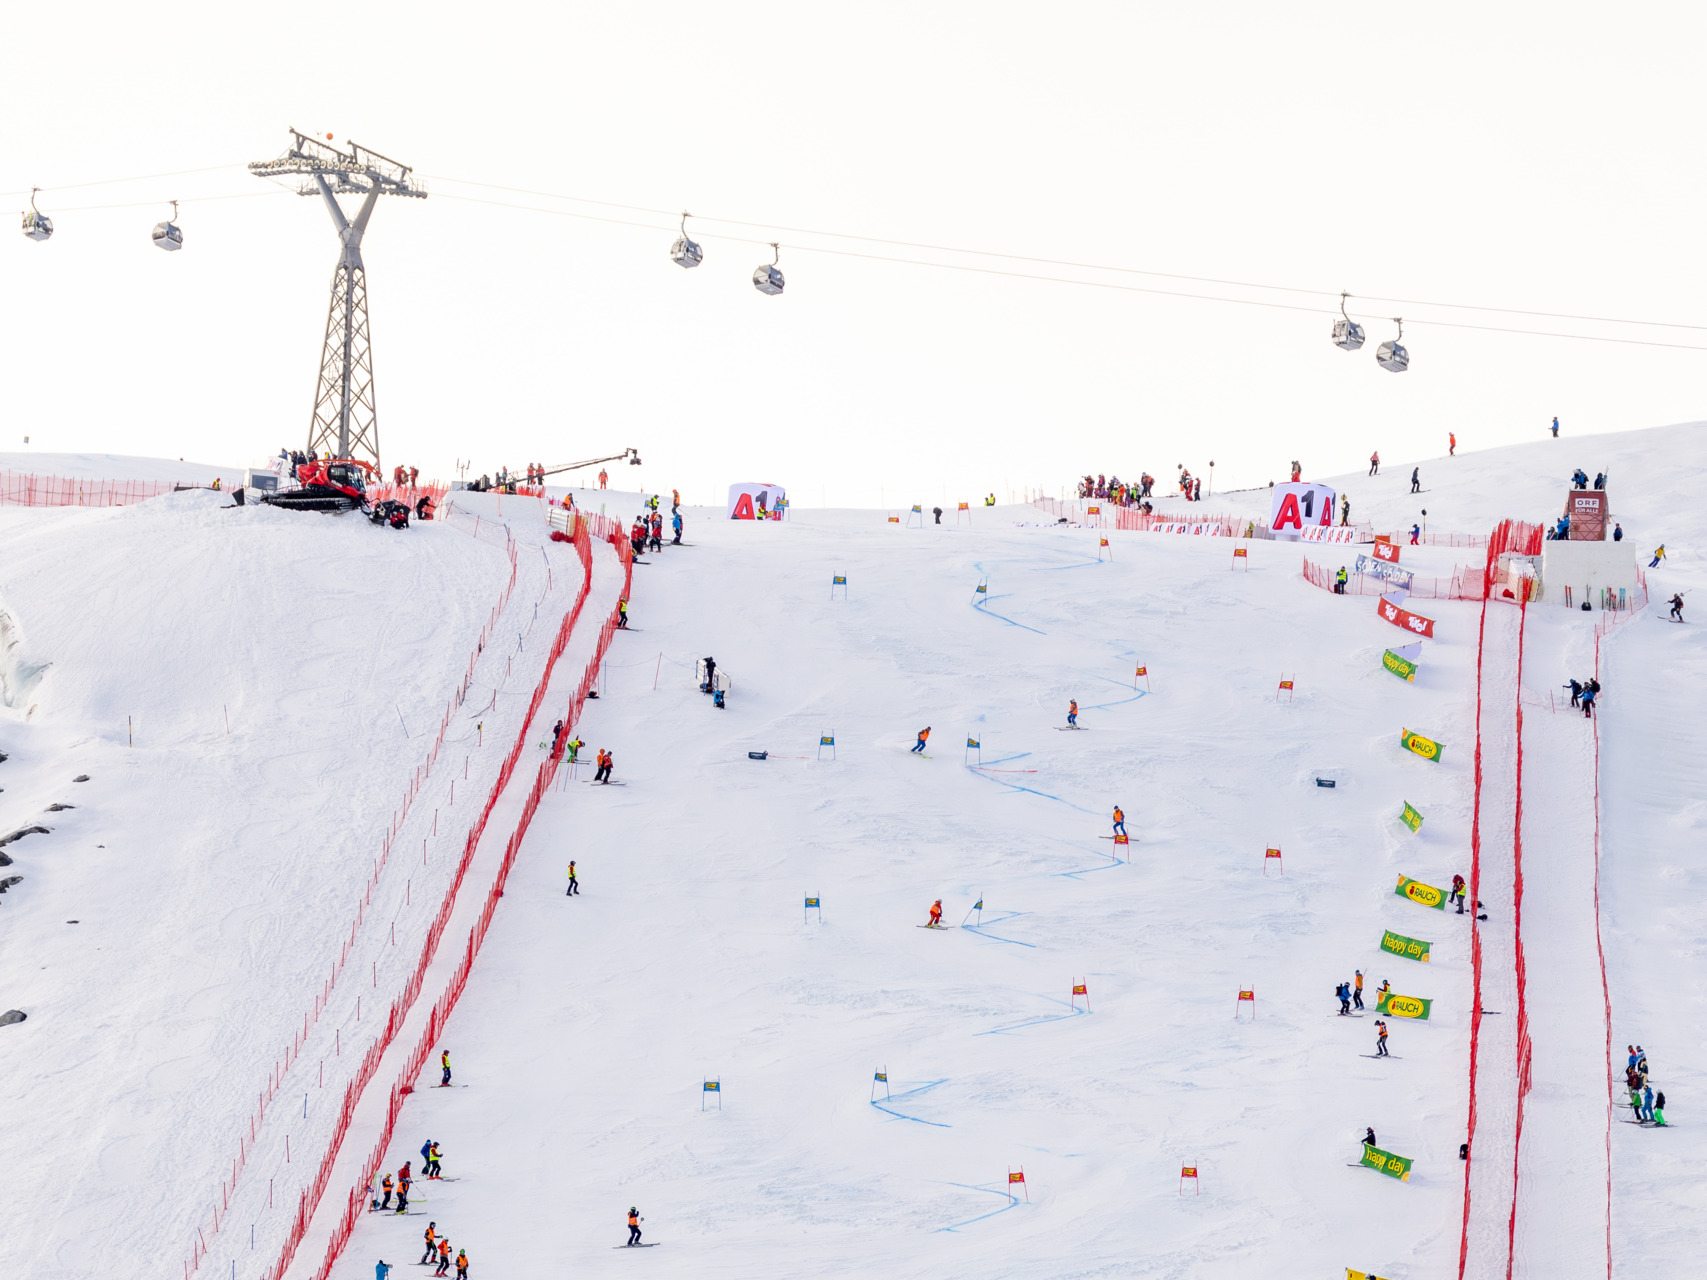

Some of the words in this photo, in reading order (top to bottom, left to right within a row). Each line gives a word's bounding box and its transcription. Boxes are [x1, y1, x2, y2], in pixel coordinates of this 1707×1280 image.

[731, 491, 767, 520] A1
[1272, 490, 1314, 530] A1
[1320, 492, 1336, 526] A1
[1408, 616, 1427, 632] Tirol
[1384, 653, 1399, 671] happy
[1398, 662, 1411, 677] day
[1415, 740, 1434, 755] RAUCH
[1414, 887, 1437, 902] RAUCH
[1384, 934, 1408, 954] happy
[1408, 942, 1423, 958] day
[1395, 1000, 1420, 1013] RAUCH
[1366, 1147, 1387, 1170] happy
[1387, 1158, 1405, 1176] day
